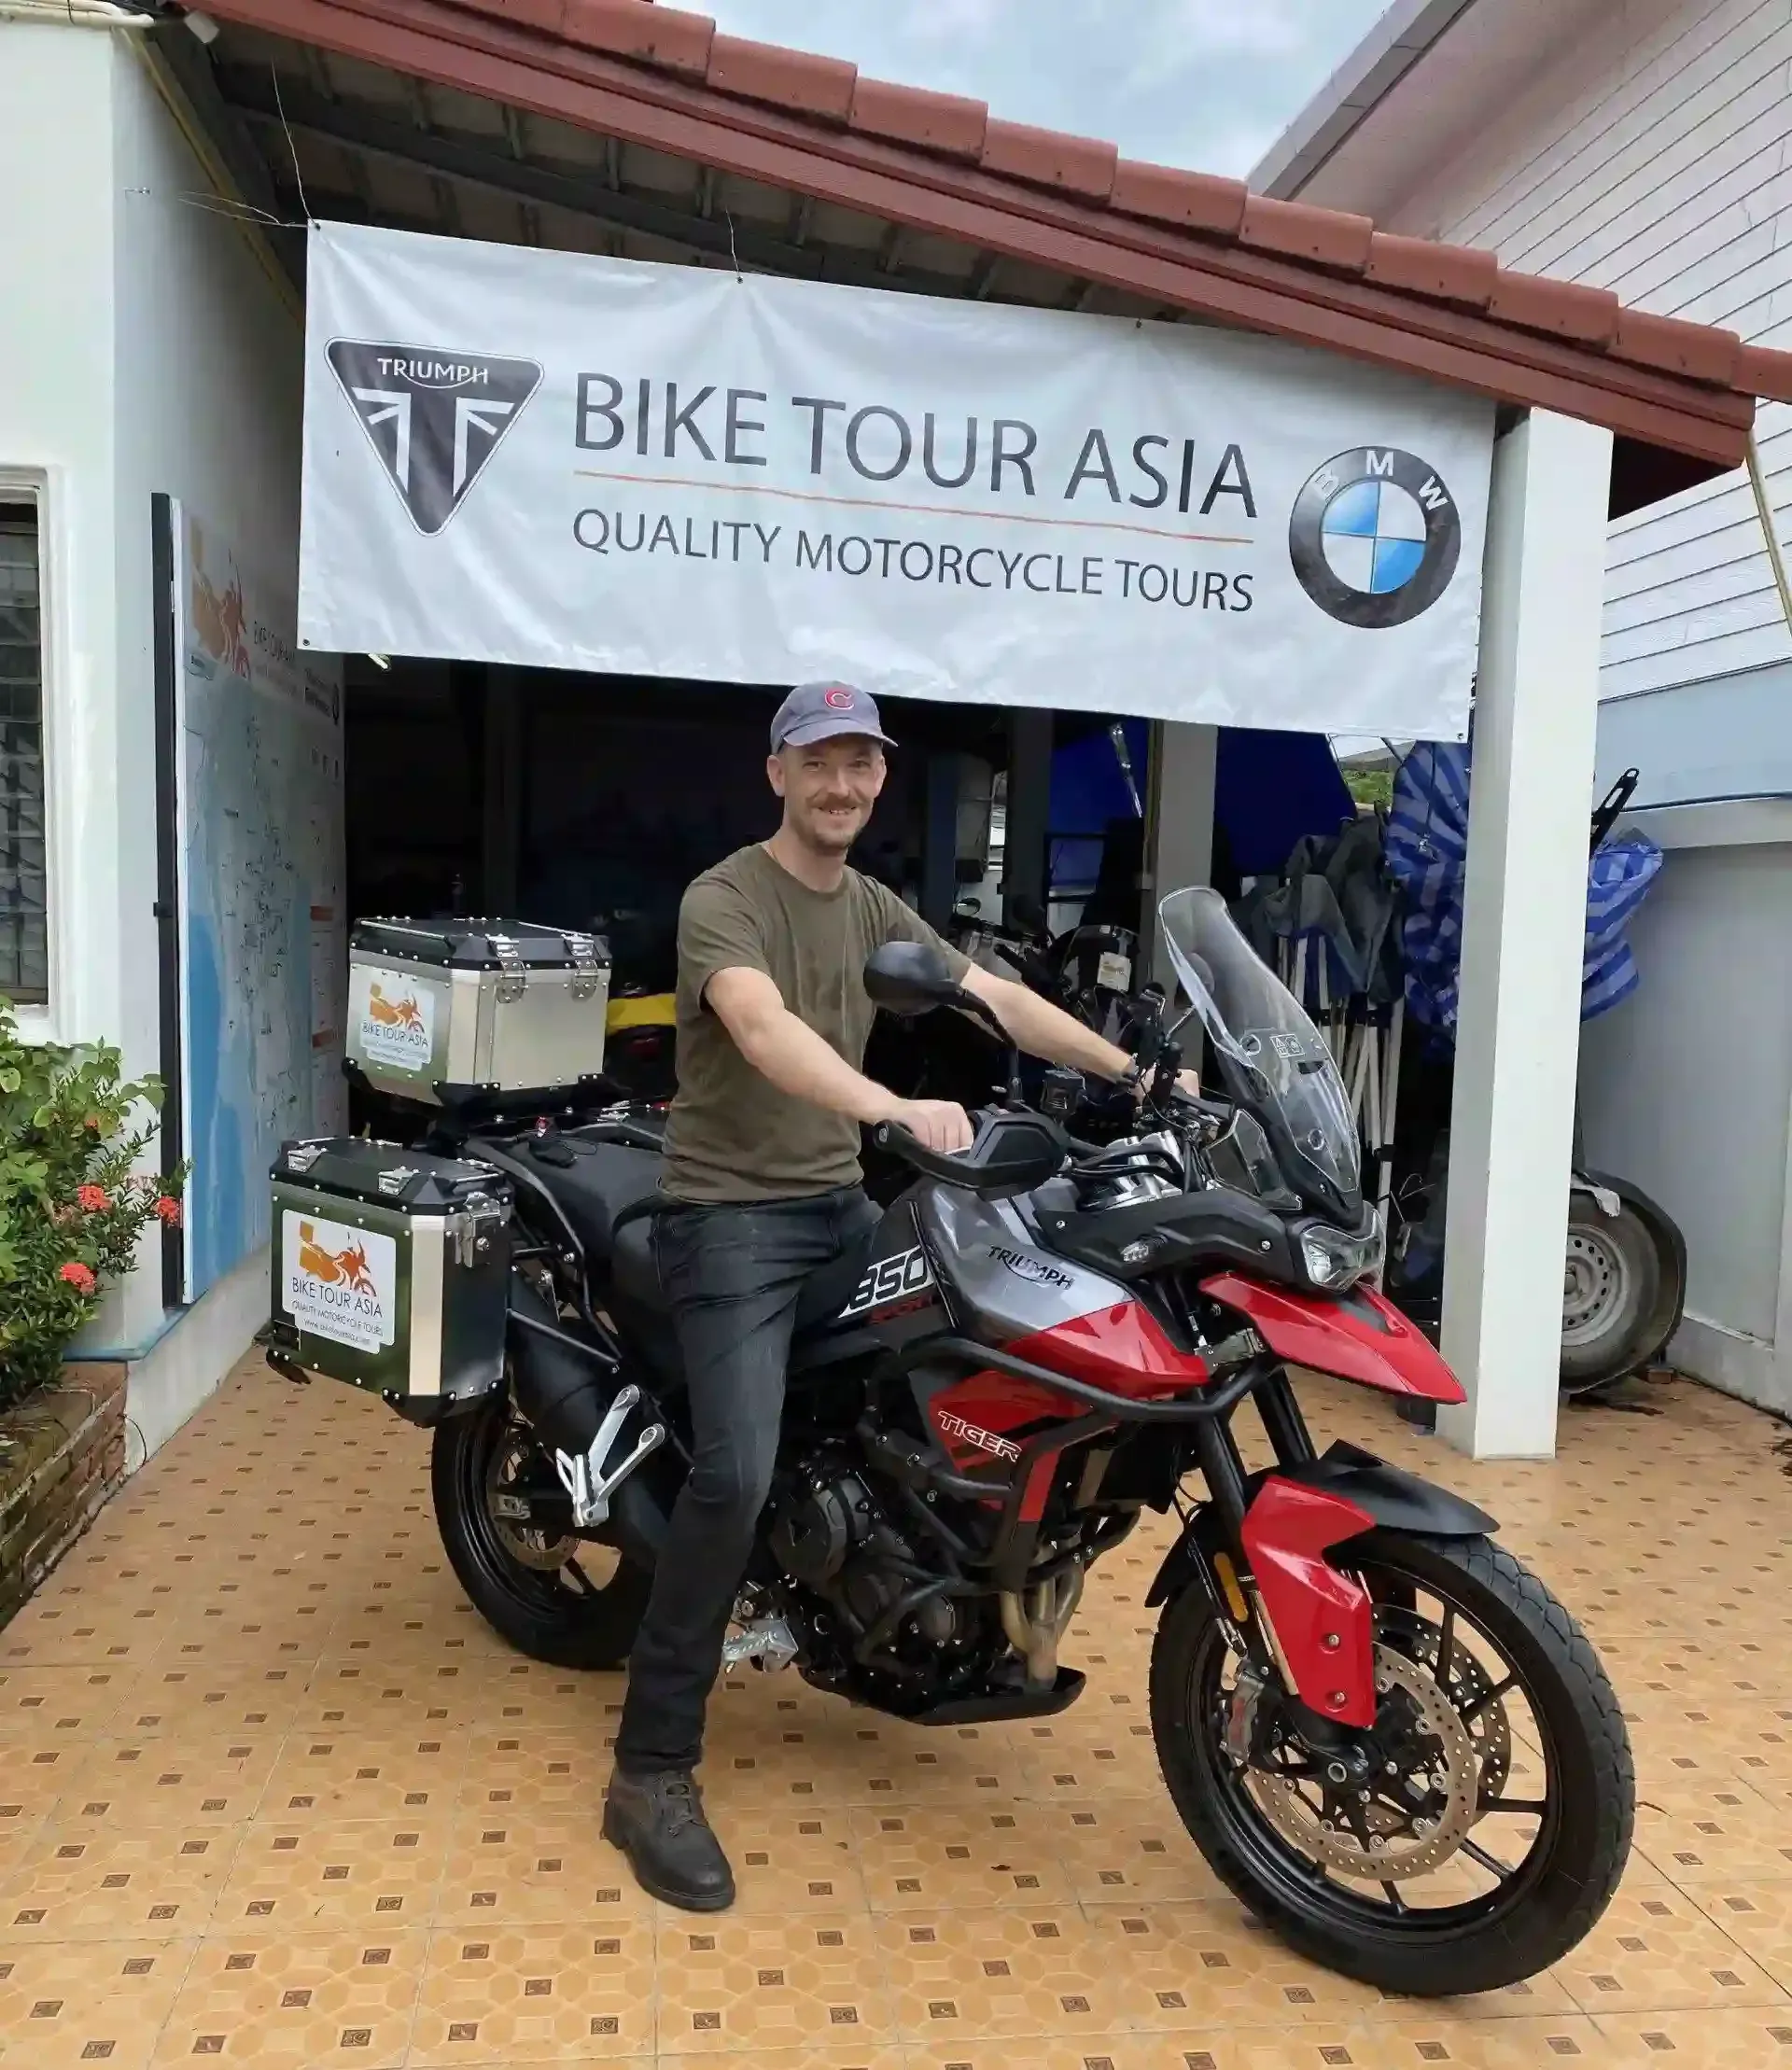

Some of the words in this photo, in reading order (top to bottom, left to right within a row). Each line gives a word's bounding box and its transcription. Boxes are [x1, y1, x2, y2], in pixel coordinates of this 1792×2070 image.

[376, 357, 490, 386] TRIUMPH
[574, 371, 768, 468] BIKE
[791, 396, 1038, 497] TOUR
[1064, 428, 1258, 519] ASIA
[1311, 450, 1448, 511] BMW
[572, 508, 782, 564] QUALITY
[795, 529, 1102, 595] MOTORCYCLE
[1114, 561, 1254, 613] TOURS
[824, 687, 856, 710] C
[362, 1021, 381, 1037] BIKE
[383, 1028, 406, 1042] TOUR
[407, 1033, 428, 1047] ASIA
[987, 1244, 1075, 1290] TRIUMPH
[292, 1277, 316, 1298] BIKE
[318, 1284, 352, 1308] TOUR
[354, 1297, 384, 1319] ASIA
[937, 1410, 1023, 1462] TIGER
